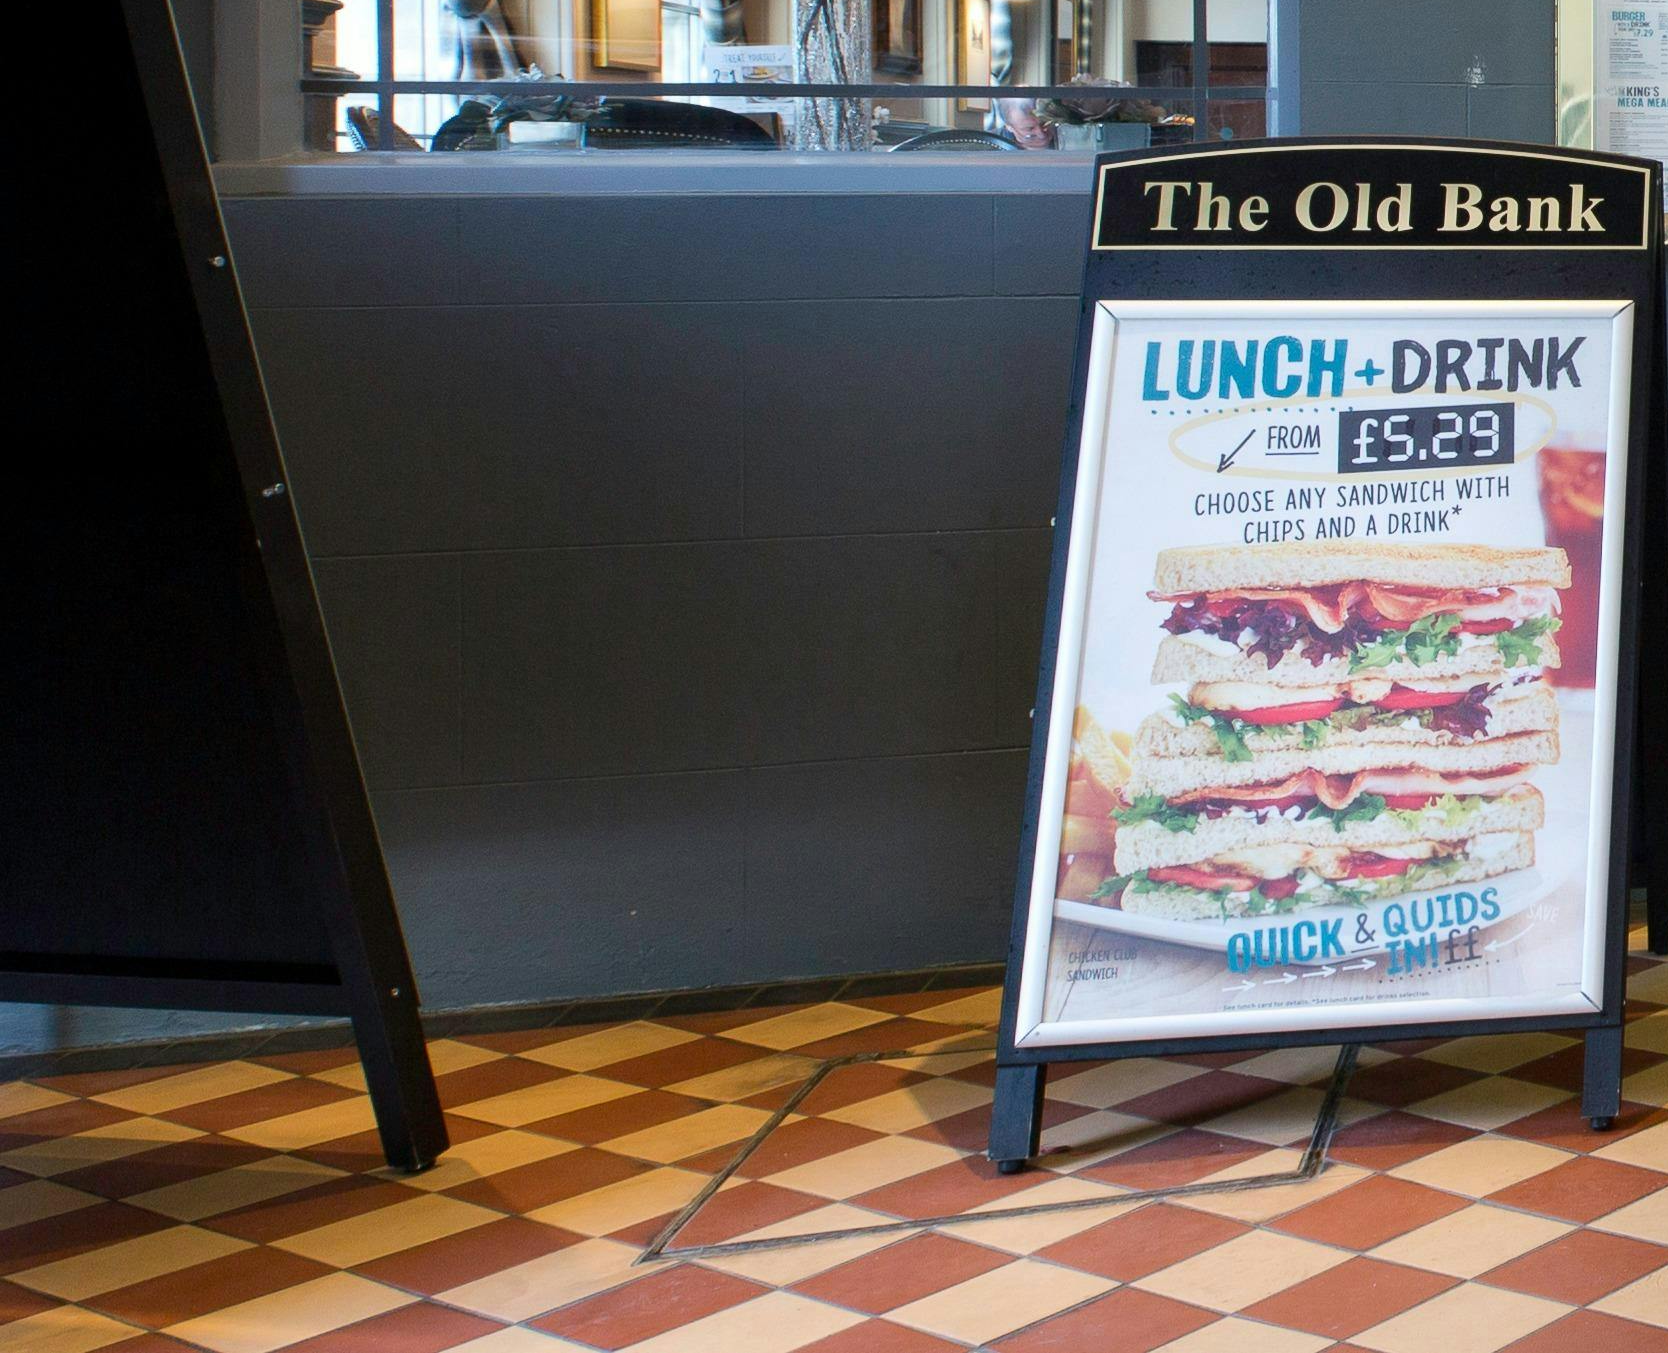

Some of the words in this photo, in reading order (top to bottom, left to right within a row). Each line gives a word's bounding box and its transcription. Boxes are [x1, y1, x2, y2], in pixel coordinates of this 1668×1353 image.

[1612, 11, 1645, 21] BURGER
[1617, 97, 1644, 107] MEGA
[1144, 180, 1270, 232] The
[1295, 181, 1412, 233] Old
[1437, 182, 1606, 233] Bank
[1266, 425, 1321, 451] FROM
[1352, 409, 1500, 465] £5.29
[1195, 492, 1276, 517] CHOOSE
[1285, 487, 1326, 512] ANY
[1337, 480, 1446, 509] SANDWICH
[1456, 478, 1510, 500] WITH
[1244, 522, 1306, 544] CHIPS
[1317, 516, 1356, 539] AND
[1367, 515, 1378, 536] A
[1525, 903, 1560, 924] SAVE
[1227, 917, 1346, 974] QUICK
[1355, 913, 1376, 945] &
[1383, 887, 1502, 937] QUIDS
[1069, 950, 1110, 963] CHICKEN
[1113, 948, 1138, 961] CLUB
[1385, 932, 1438, 976] IN!
[1067, 967, 1118, 982] SANDWICH
